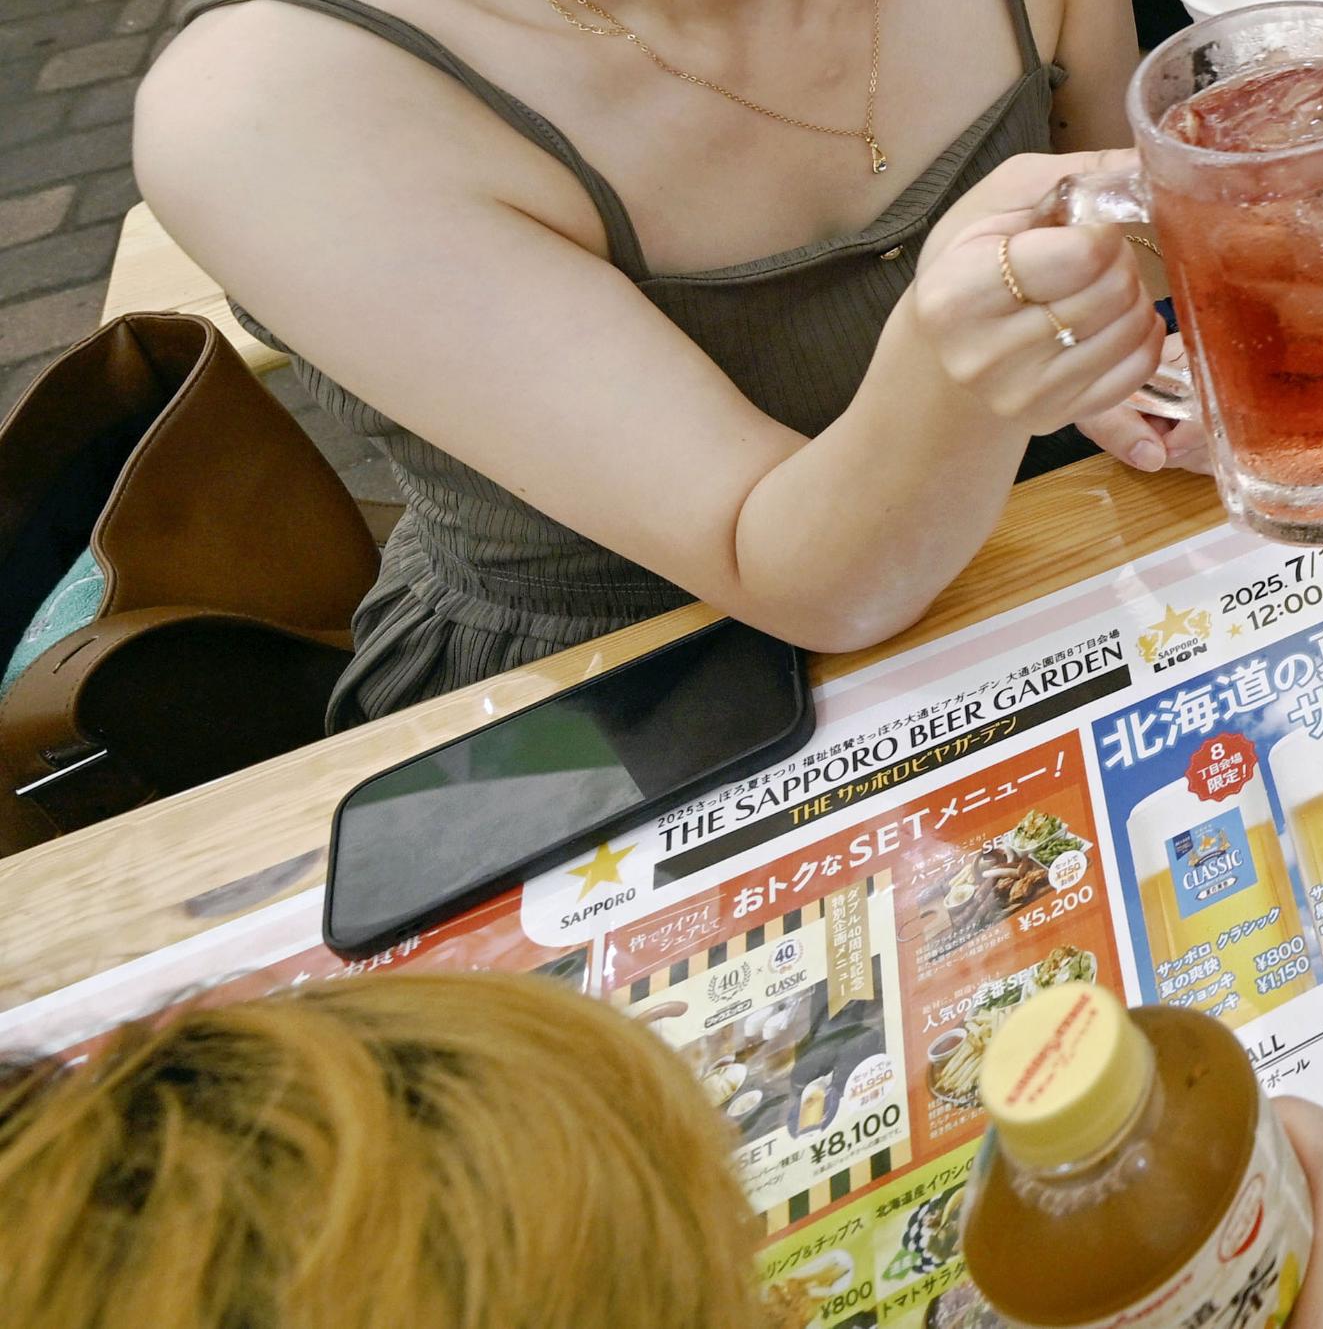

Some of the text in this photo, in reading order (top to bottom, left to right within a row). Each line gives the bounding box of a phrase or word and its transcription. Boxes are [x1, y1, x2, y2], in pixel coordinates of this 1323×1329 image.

[1219, 574, 1289, 615] 2025.
[1246, 584, 1323, 631] 12:00
[1005, 627, 1122, 684] 大通公園西8丁目会場
[1153, 643, 1208, 673] LION
[1157, 637, 1199, 660] SAPPORO
[659, 641, 1125, 853] THE SAPPORO BEER GARDEN
[1197, 754, 1243, 780] 丁目会場
[1210, 743, 1225, 760] 8
[789, 716, 1019, 825] THE サッポロビヤガーデン
[1207, 766, 1247, 794] 限定！
[733, 751, 1065, 919] おトクなSETメニュー！
[1182, 848, 1243, 891] CLASSIC
[560, 887, 637, 930] SAPPORO
[1017, 885, 1094, 934] ¥5,200
[628, 906, 710, 954] 皆でワイワイ
[660, 917, 720, 953] シェアして
[831, 896, 850, 998] 特別企画メニュー
[845, 887, 865, 993] ダブル40周年記念
[1156, 906, 1282, 977] サッポロ クラシック
[774, 944, 796, 963] 40
[1254, 936, 1305, 972] ¥800
[718, 969, 740, 990] 40
[765, 970, 807, 997] CLASSIC
[1159, 956, 1221, 997] 夏の爽快
[1256, 956, 1311, 996] ¥1,150
[809, 1104, 901, 1164] ¥8,100
[820, 1281, 873, 1321] ¥800
